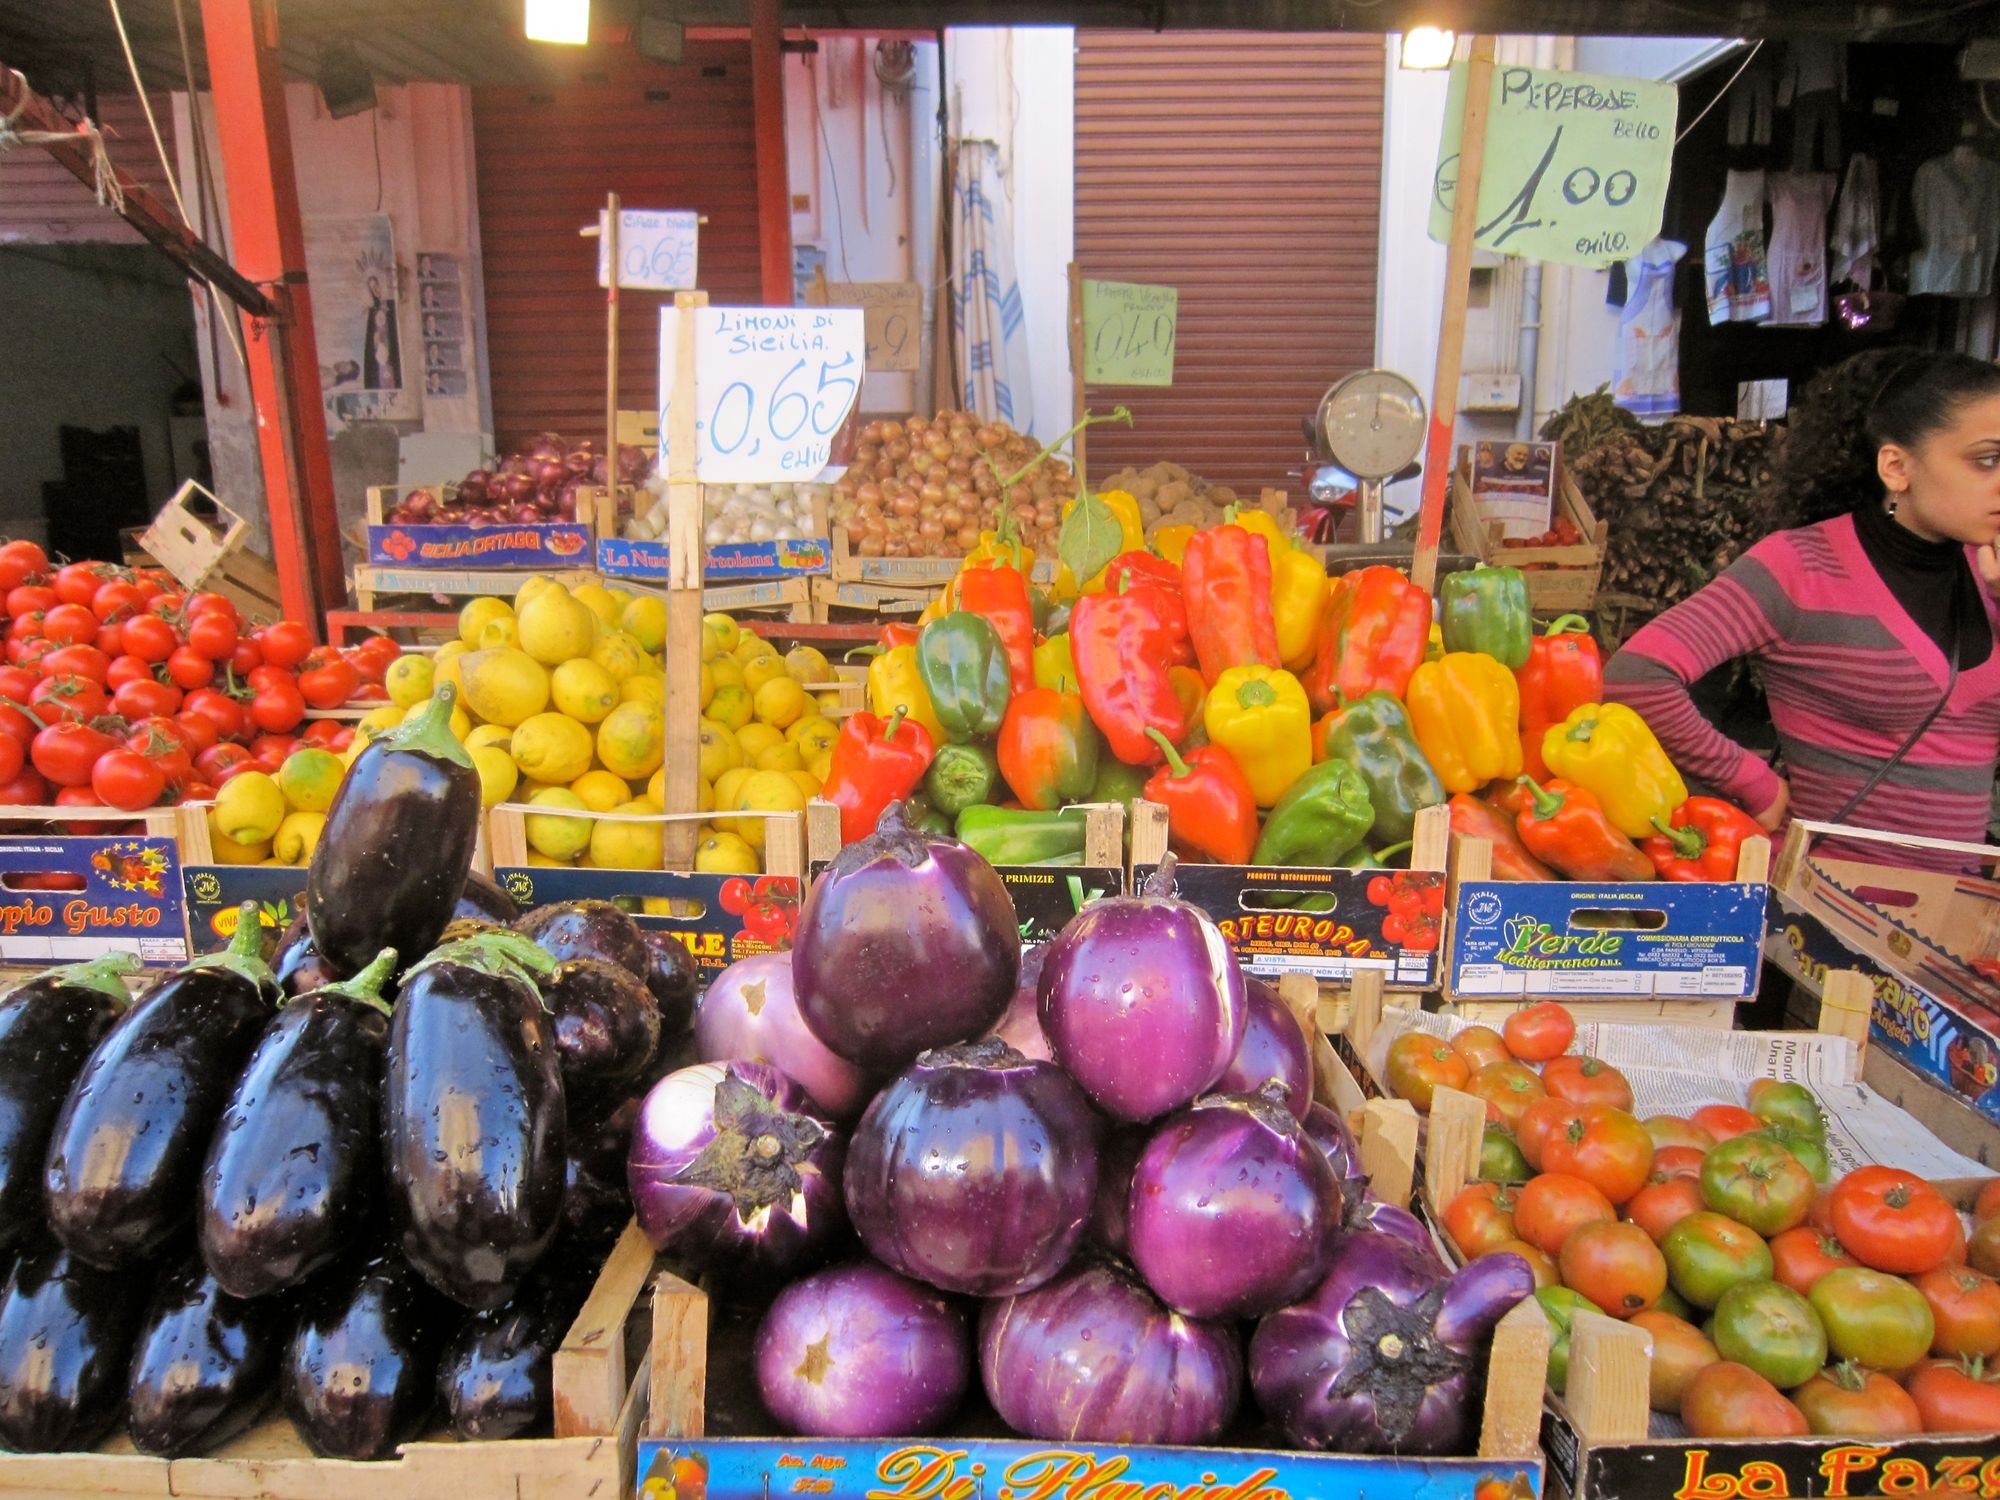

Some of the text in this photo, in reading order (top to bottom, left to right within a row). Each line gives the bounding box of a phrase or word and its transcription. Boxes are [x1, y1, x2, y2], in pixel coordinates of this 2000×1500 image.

[710, 351, 857, 457] 0,65
[472, 530, 542, 555] ORTAGGI
[606, 547, 628, 567] La
[1006, 874, 1055, 884] PRIMIZIE
[1246, 872, 1277, 880] PRODOTTI
[1472, 890, 1499, 901] ITALIA
[1570, 892, 1597, 900] ORIGINE:
[63, 899, 161, 934] Gusto
[1511, 923, 1624, 956] Verde
[1690, 935, 1744, 943] ORTOFRUTTICOLA
[1767, 1040, 1783, 1065] Una
[776, 1454, 848, 1470] Az. Agr.
[866, 1446, 986, 1500] Di
[1673, 1450, 1790, 1500] La
